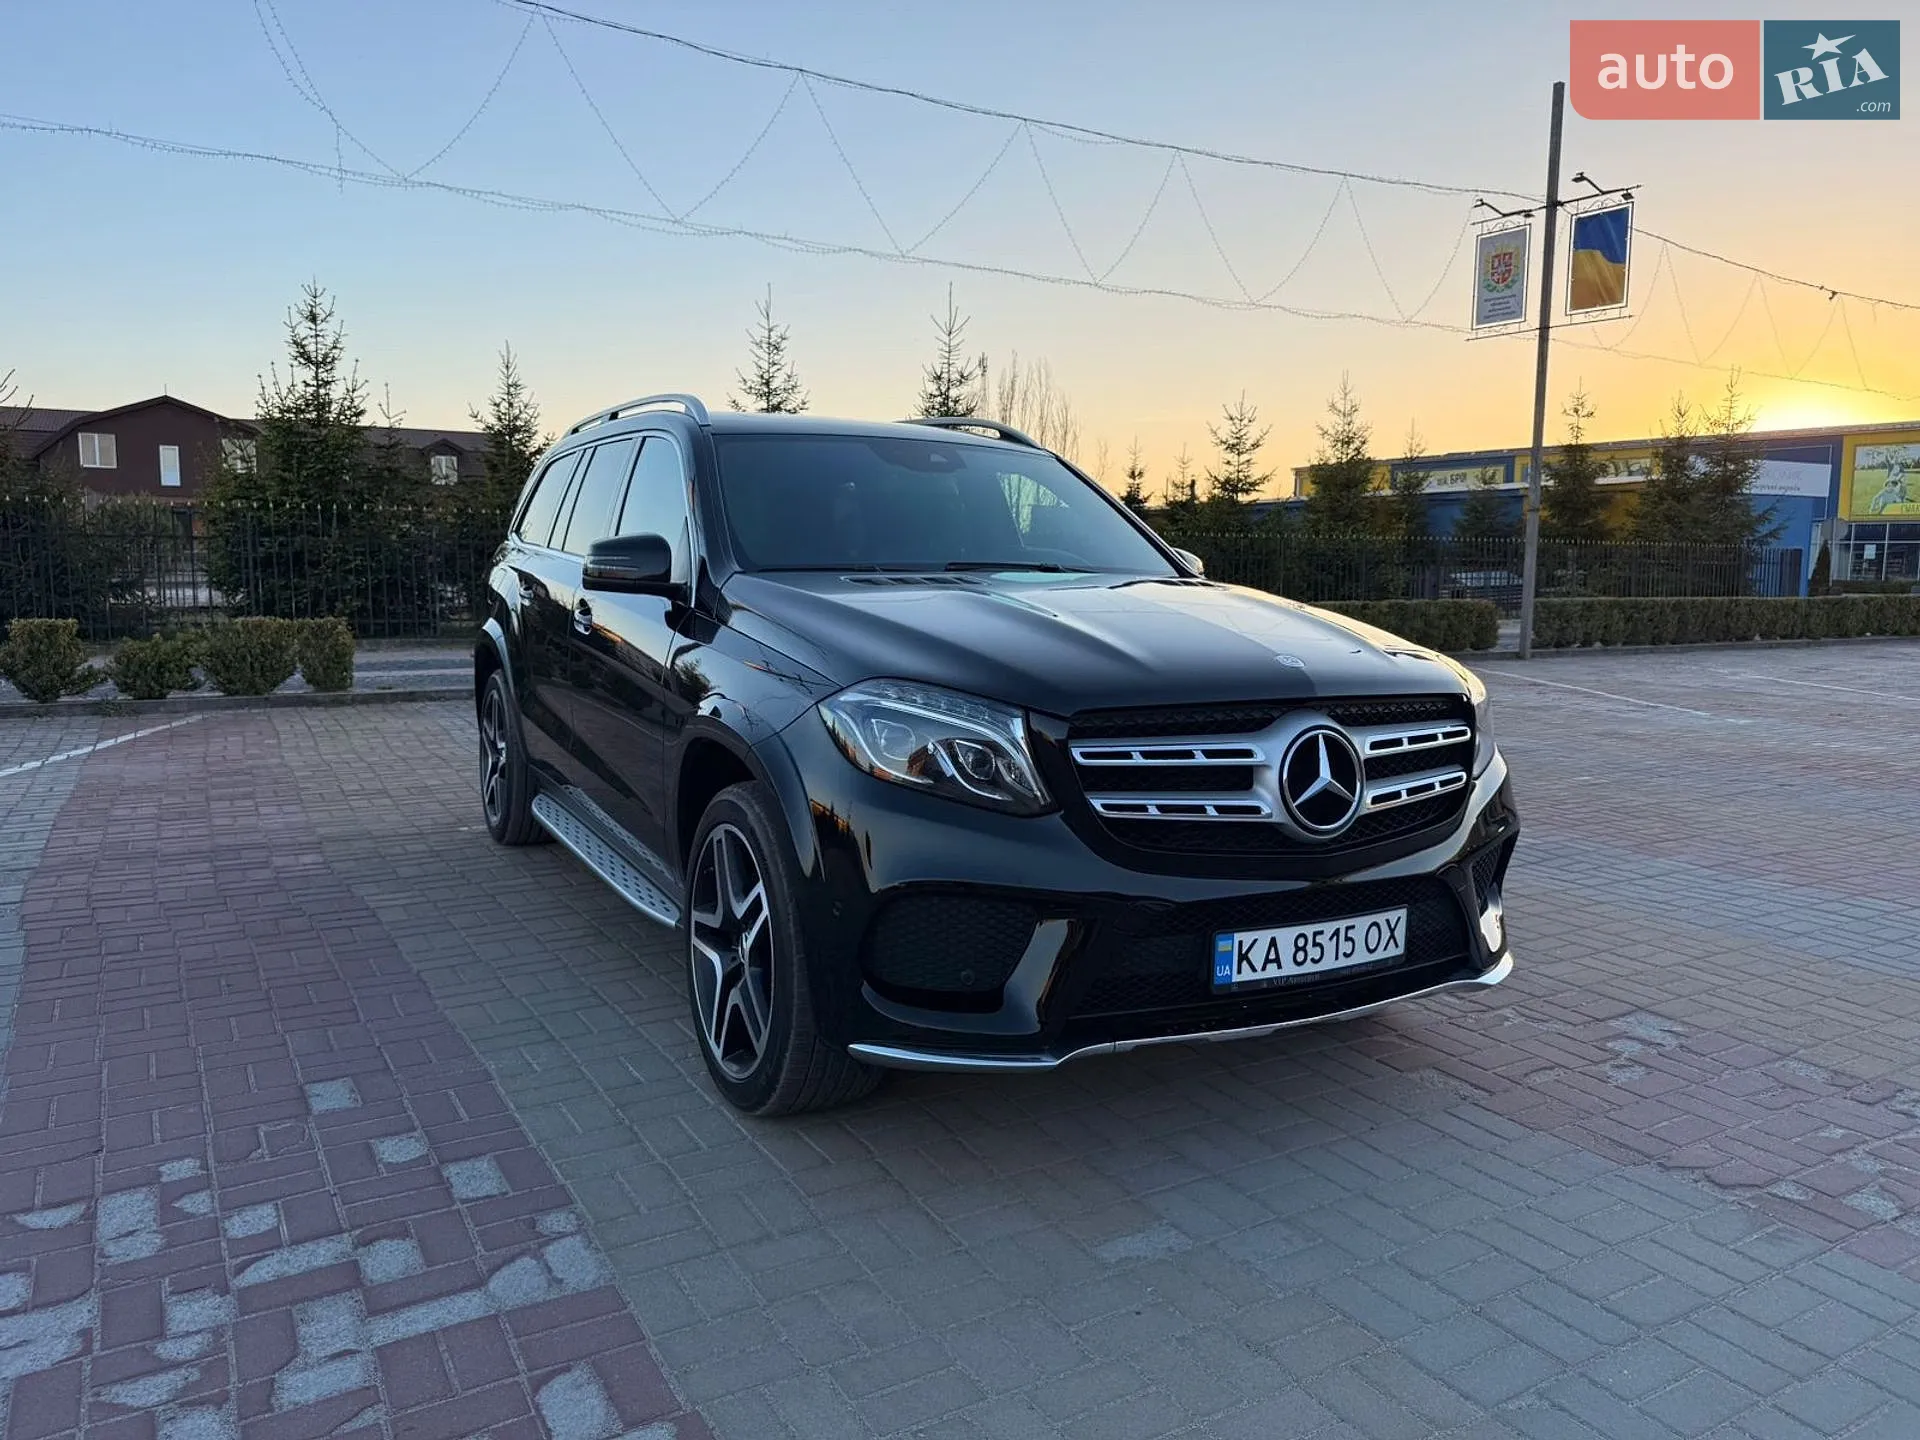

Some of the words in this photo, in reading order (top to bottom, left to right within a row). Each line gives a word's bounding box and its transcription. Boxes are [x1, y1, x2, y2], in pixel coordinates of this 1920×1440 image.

[1237, 936, 1282, 975] KA
[1292, 925, 1356, 967] 8515
[1364, 916, 1402, 954] OX
[1216, 965, 1231, 977] UA
